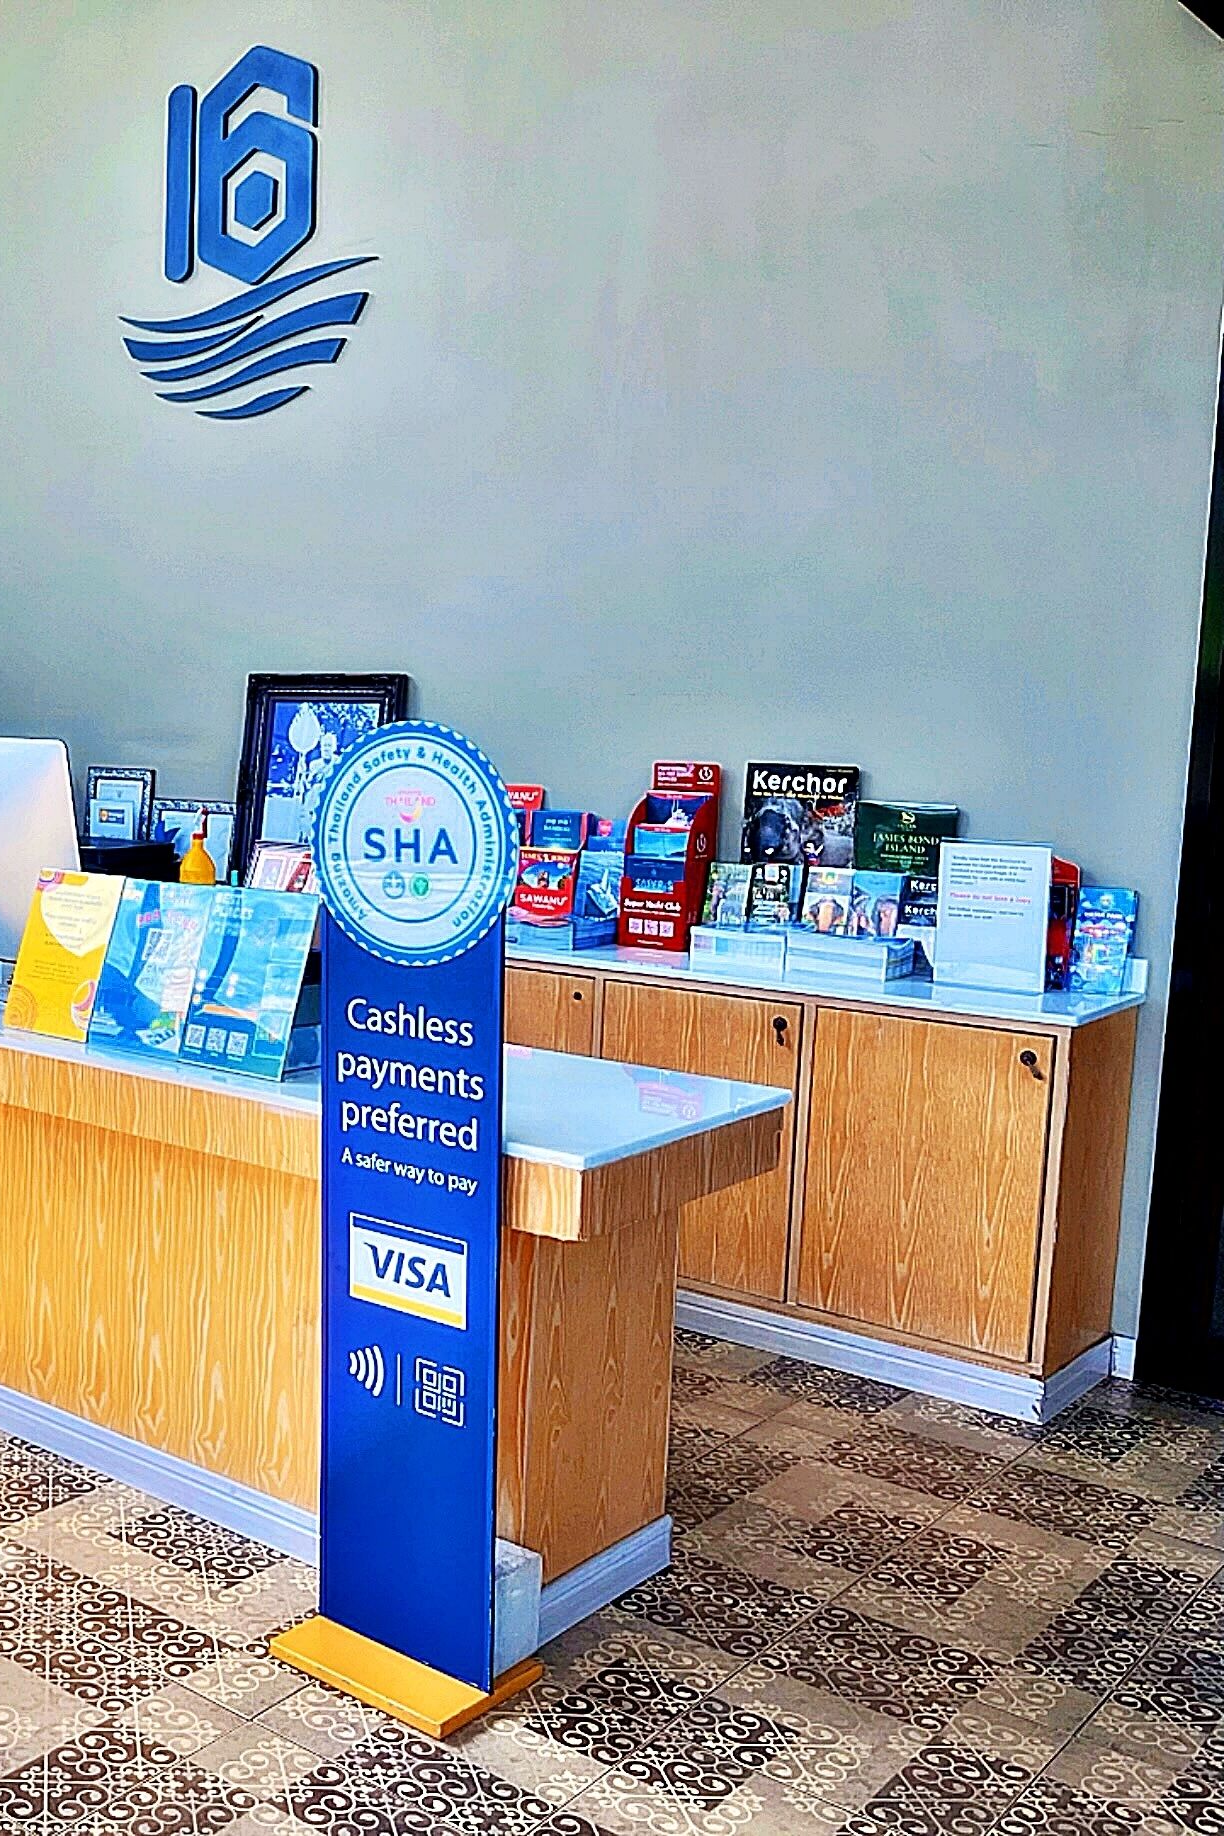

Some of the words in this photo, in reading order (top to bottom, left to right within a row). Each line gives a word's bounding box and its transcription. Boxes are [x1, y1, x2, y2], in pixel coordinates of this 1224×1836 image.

[362, 747, 412, 775] Safety
[416, 746, 427, 760] &
[431, 752, 477, 795] Health
[752, 769, 848, 794] Kerchor
[327, 773, 362, 843] Thailand
[363, 827, 458, 865] SHA
[872, 832, 905, 843] JAMES
[907, 835, 940, 846] BOND
[885, 843, 926, 854] ISLAND
[328, 852, 368, 921] Amazing
[452, 799, 497, 929] Administration
[347, 998, 474, 1047] Cashless
[337, 1051, 484, 1101] payments
[341, 1101, 478, 1151] preferred
[341, 1147, 353, 1165] A
[355, 1153, 391, 1174] safer
[393, 1163, 426, 1185] way
[427, 1168, 445, 1186] to
[447, 1174, 478, 1197] pay
[363, 1241, 452, 1298] VISA
